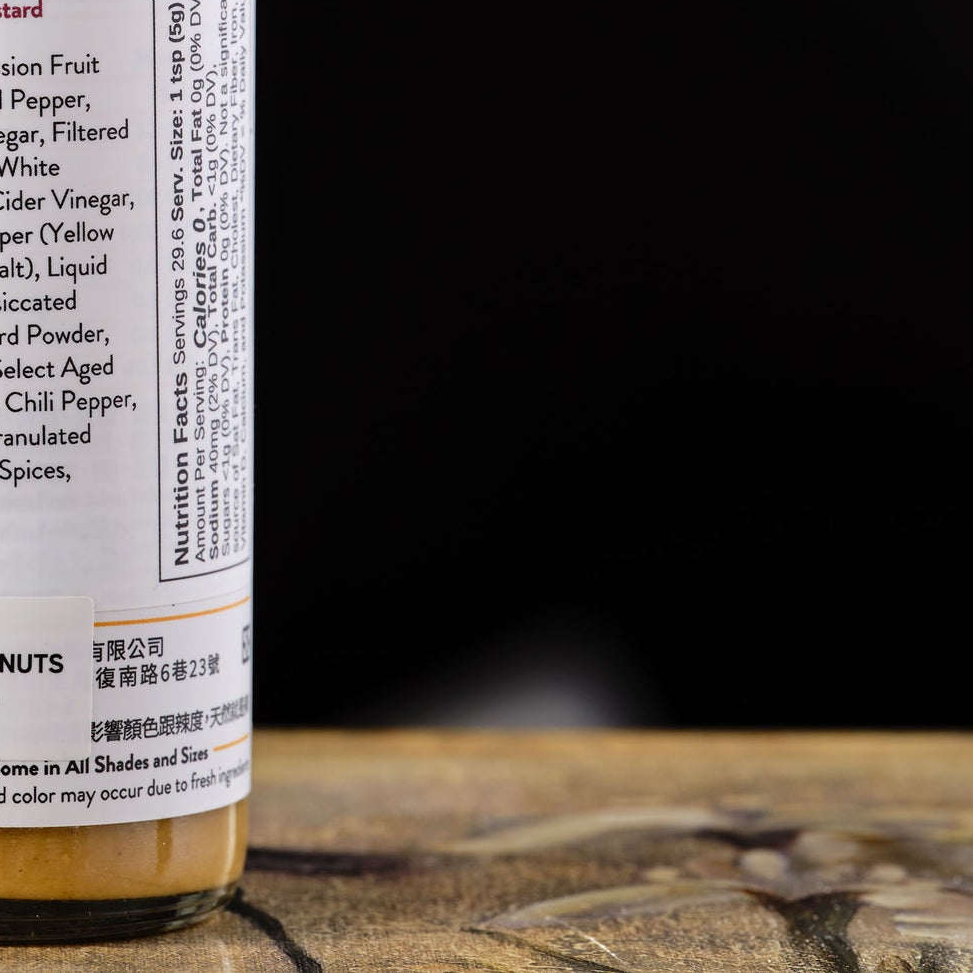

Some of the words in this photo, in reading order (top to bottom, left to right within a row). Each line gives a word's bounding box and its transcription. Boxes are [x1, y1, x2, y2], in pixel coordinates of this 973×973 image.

[168, 2, 185, 43] (5g)
[50, 54, 100, 75] Fruit
[170, 50, 185, 84] tsp
[189, 33, 204, 71] (0%
[11, 89, 91, 117] Pepper,
[170, 89, 183, 102] 1
[191, 79, 204, 103] 0g
[220, 83, 228, 95] a
[52, 118, 129, 142] Filtered
[170, 110, 184, 161] Size:
[191, 108, 203, 142] Fat
[205, 114, 218, 152] (0%
[219, 101, 229, 136] Not
[230, 113, 240, 183] Dietary
[170, 167, 184, 222] Serv.
[191, 149, 203, 202] Total
[206, 159, 218, 196] <1g
[51, 189, 135, 215] Vinegar,
[219, 192, 231, 230] (0%
[40, 221, 114, 245] (Yellow
[206, 202, 217, 259] Carb.
[220, 237, 230, 262] 0g
[47, 254, 107, 284] Liquid
[171, 228, 185, 272] 29.6
[192, 241, 207, 349] Calories
[207, 266, 218, 318] Total
[220, 268, 229, 343] Protein
[27, 323, 110, 346] Powder,
[172, 278, 188, 365] Servings
[60, 354, 113, 385] Aged
[5, 391, 53, 413] Chili
[62, 390, 137, 417] Pepper,
[173, 372, 188, 444] Facts
[193, 361, 207, 440] Serving:
[208, 373, 220, 412] (2%
[221, 399, 231, 437] (0%
[194, 447, 205, 481] Per
[208, 419, 220, 473] 40mg
[221, 445, 231, 481] <1g
[173, 452, 189, 566] Nutrition
[195, 486, 206, 563] Amount
[209, 480, 219, 560] Sodium
[221, 487, 231, 557] Sugars
[0, 653, 64, 674] NUTS
[44, 762, 60, 775] in
[66, 759, 89, 774] All
[95, 756, 149, 773] Shades
[153, 749, 177, 768] and
[181, 747, 208, 763] Sizes
[12, 786, 56, 804] color
[61, 789, 96, 808] may
[100, 785, 143, 801] occur
[147, 779, 172, 796] due
[175, 780, 188, 792] to
[191, 772, 216, 790] fresh
